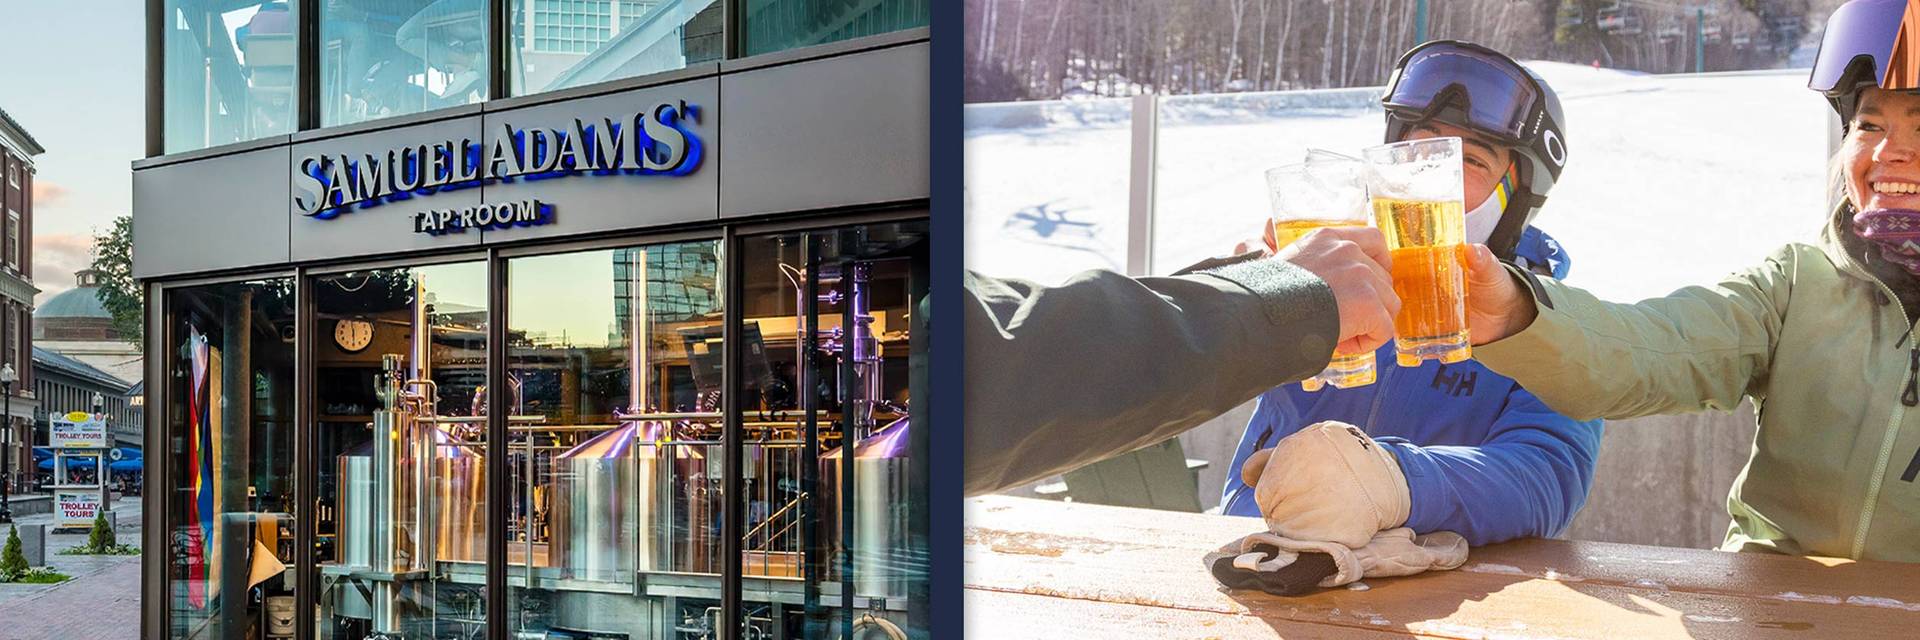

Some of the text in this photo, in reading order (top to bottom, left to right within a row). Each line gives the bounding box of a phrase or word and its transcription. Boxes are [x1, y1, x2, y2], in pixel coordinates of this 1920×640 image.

[295, 100, 694, 217] SAMUEL ADAMS
[409, 200, 541, 233] TAP ROOM
[60, 502, 99, 510] TROLLEY
[64, 510, 95, 518] TOURS
